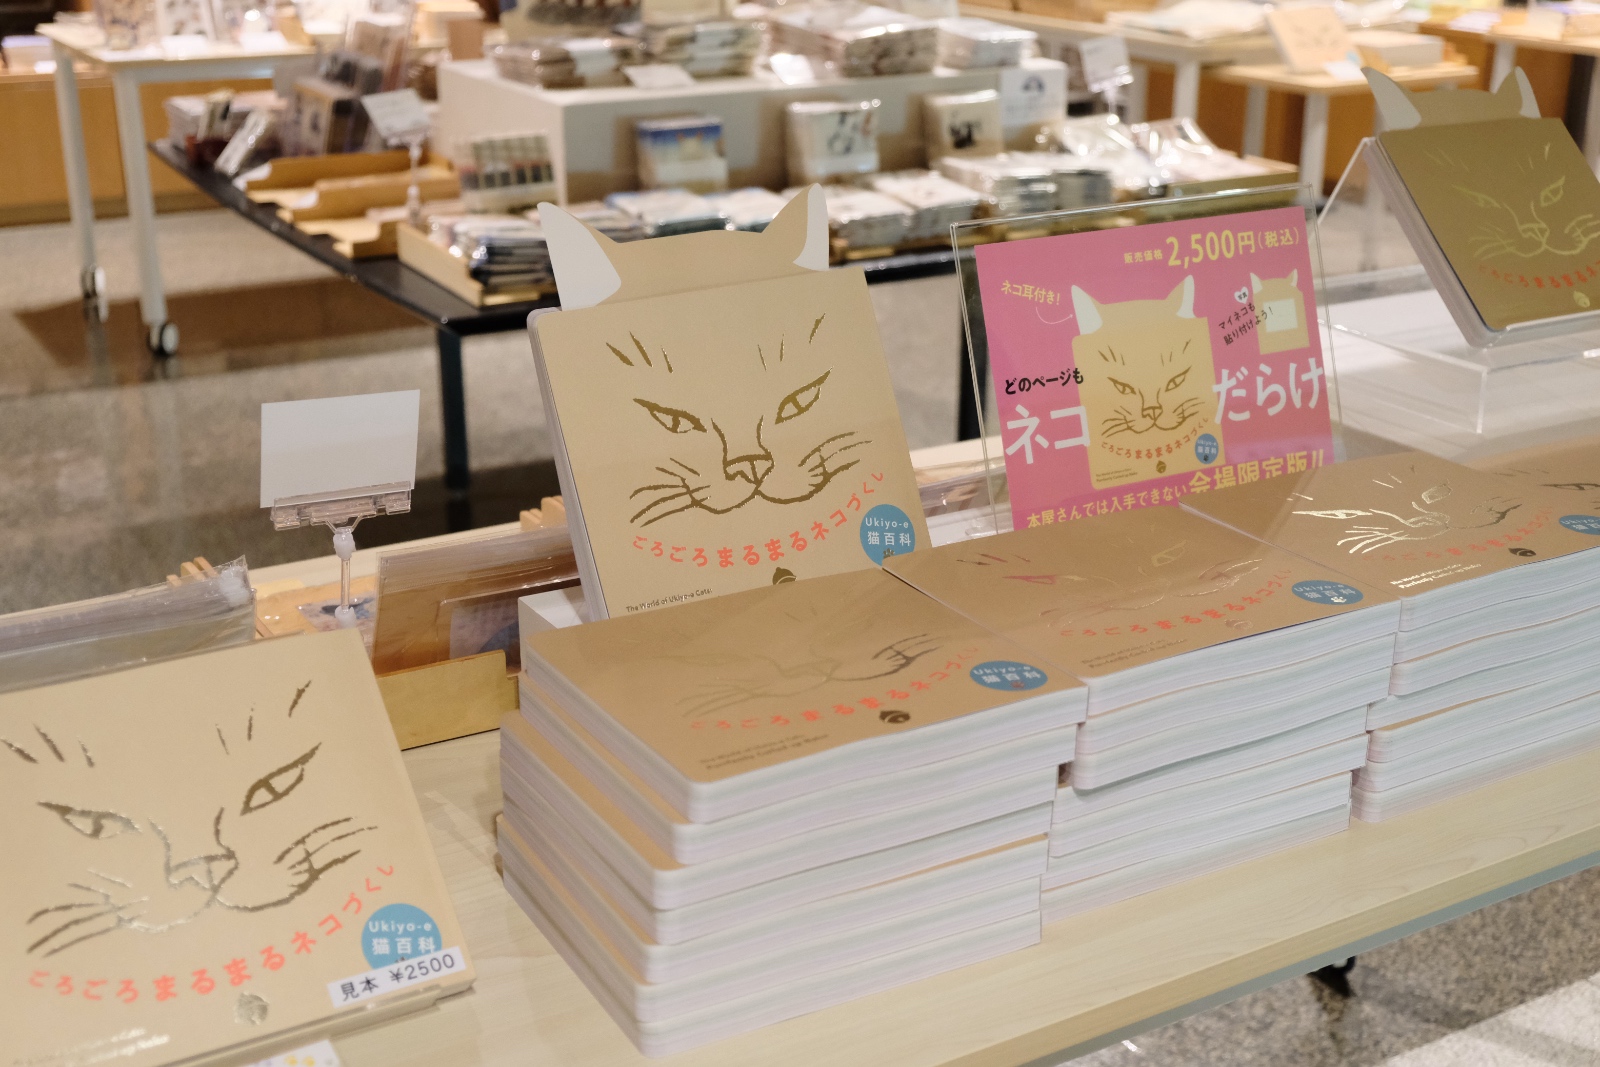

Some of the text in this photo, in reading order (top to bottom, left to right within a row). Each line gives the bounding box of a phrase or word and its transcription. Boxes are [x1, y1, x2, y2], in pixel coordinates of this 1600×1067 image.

[1124, 249, 1163, 264] 販売価格
[1001, 280, 1061, 305] ネコ耳付き!
[1218, 303, 1256, 330] マイネコも
[1223, 306, 1274, 346] 貼り付けよう!
[1005, 368, 1084, 395] どのページも
[1005, 357, 1324, 465] ネコ だらけ
[632, 471, 884, 568] ごろごろまるまるネコづくし
[1027, 485, 1187, 528] 本屋さんでは入手できない
[865, 517, 909, 530] Ukiyo-e
[868, 531, 911, 547] 猫百科
[29, 865, 394, 1003] ごろごろまるまるネコづくし
[368, 920, 432, 935] Ukiyo-e
[371, 936, 436, 955] 猫百科
[340, 954, 455, 1001] 見本 ¥2500
